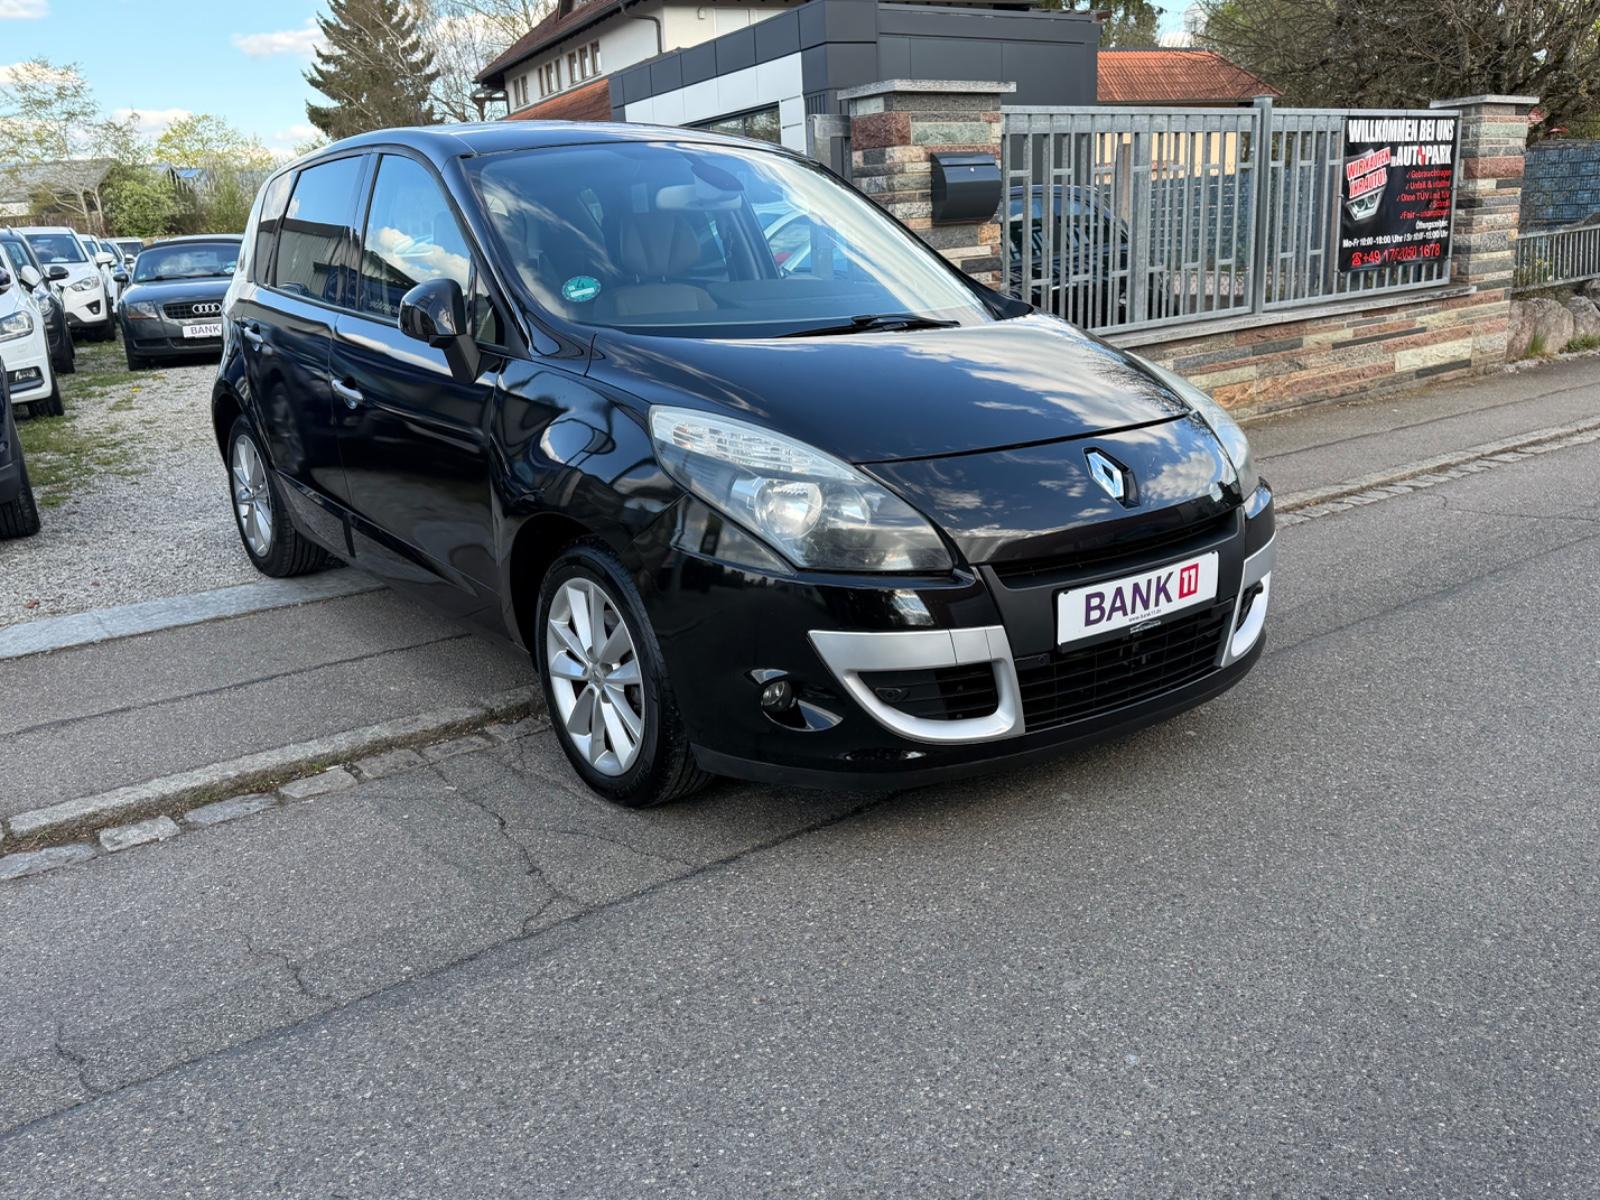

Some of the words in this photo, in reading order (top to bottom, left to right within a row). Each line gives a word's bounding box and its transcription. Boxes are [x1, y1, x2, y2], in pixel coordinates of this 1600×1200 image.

[1348, 119, 1418, 143] WILLKOMMEN
[1419, 119, 1435, 141] BEI
[1436, 118, 1455, 141] UNS
[1391, 234, 1404, 243] Uhr
[1419, 243, 1441, 258] 1678
[190, 325, 221, 335] BANK
[1084, 571, 1174, 627] BANK
[1180, 566, 1198, 596] 11
